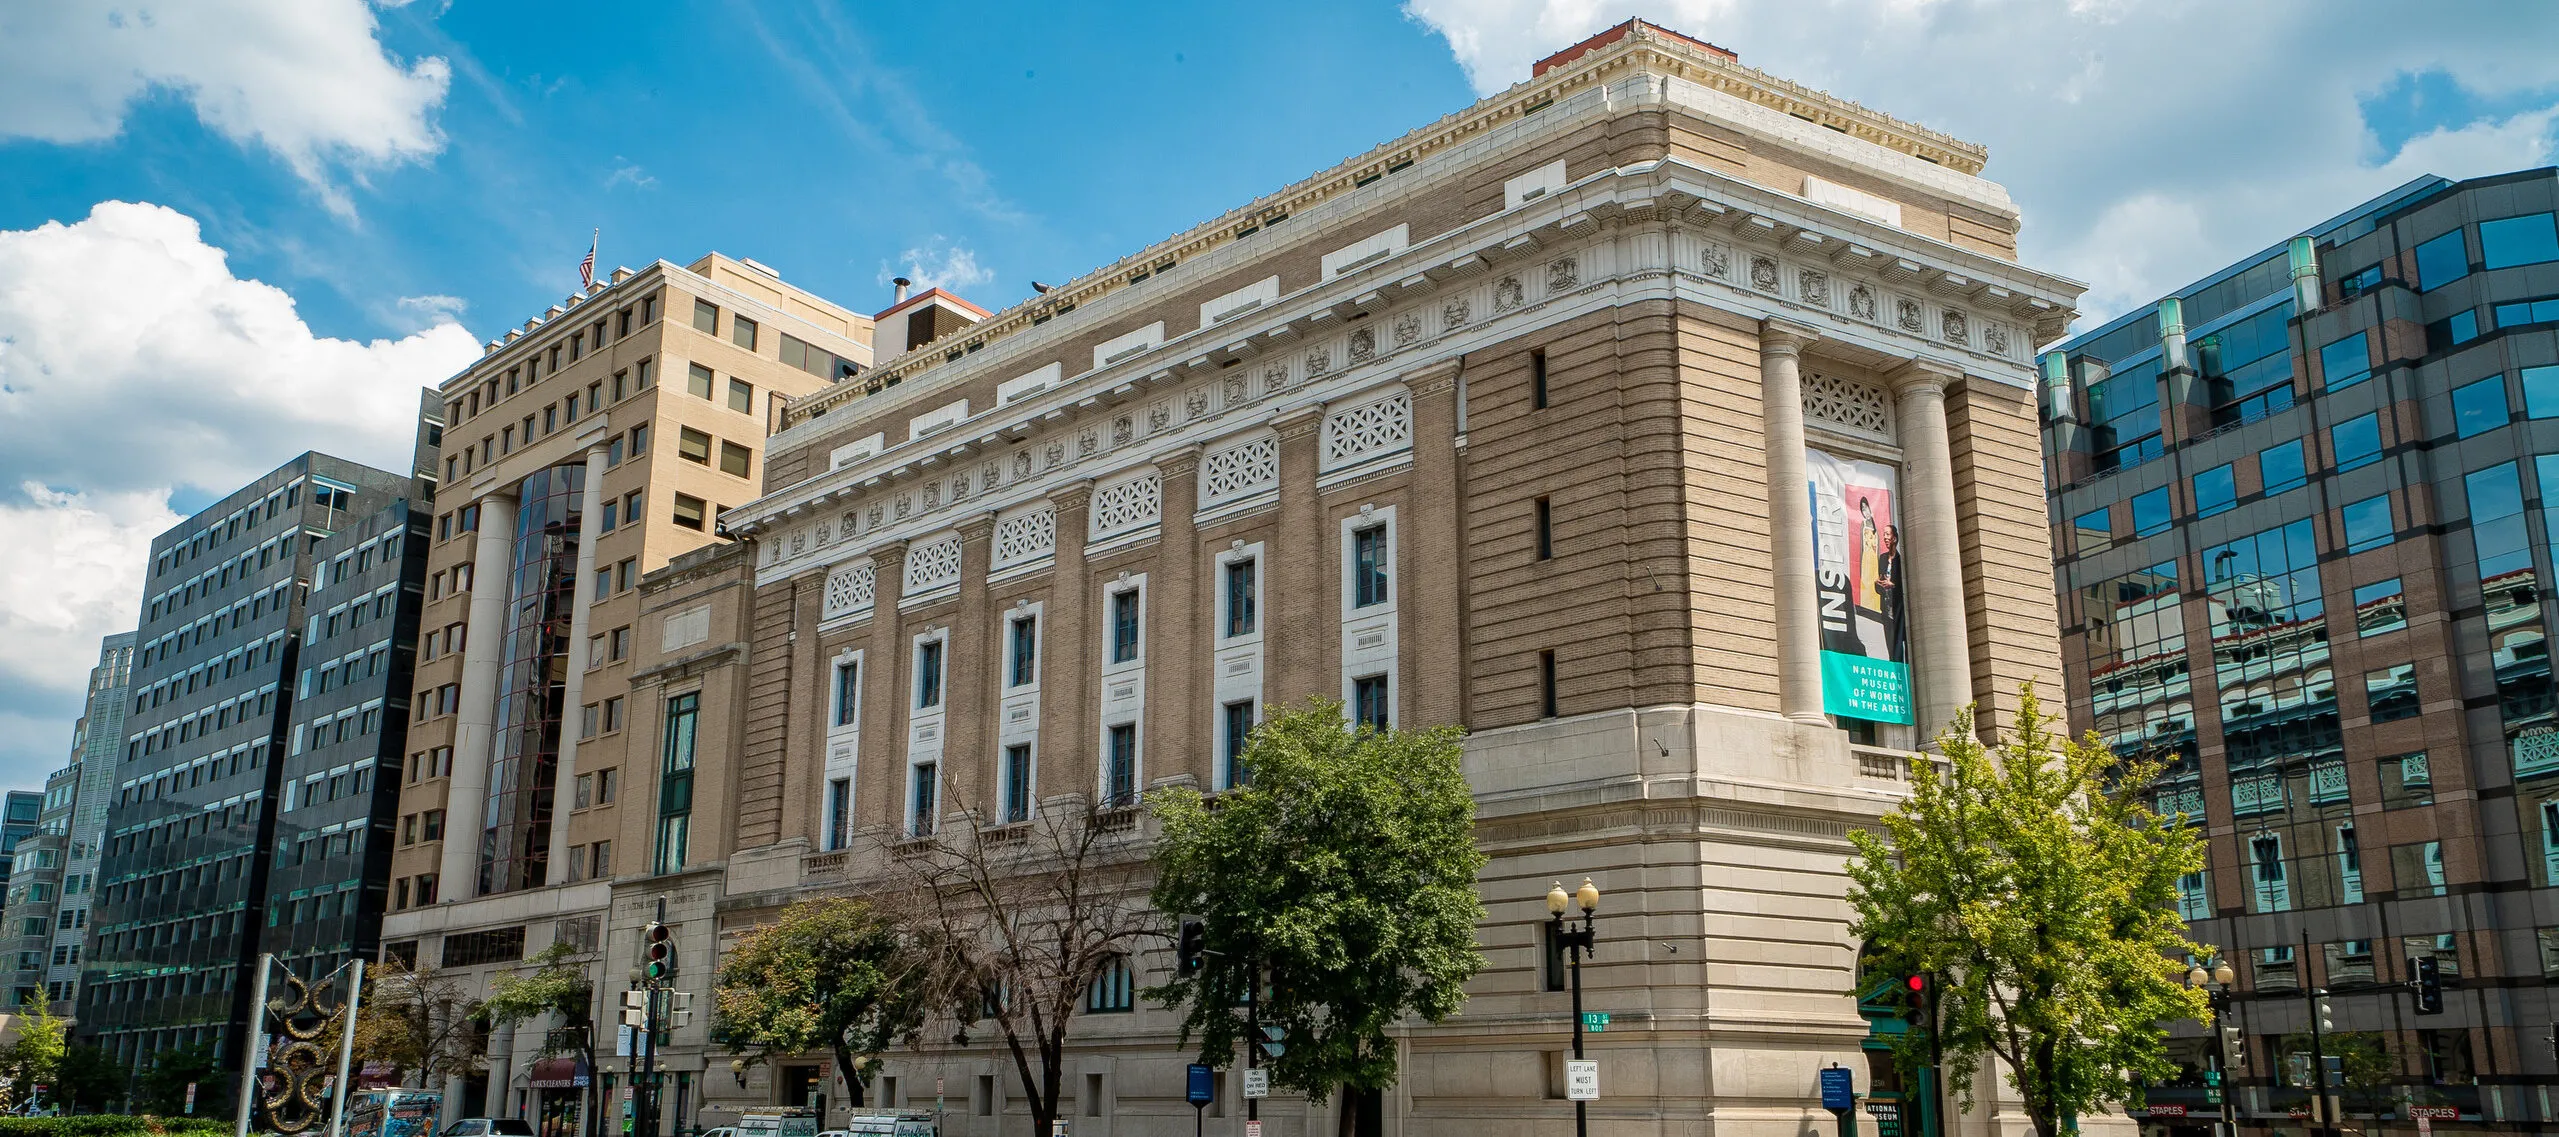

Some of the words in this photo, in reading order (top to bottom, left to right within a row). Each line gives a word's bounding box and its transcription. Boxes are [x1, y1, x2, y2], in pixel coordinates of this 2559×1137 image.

[1852, 665, 1902, 681] NATIONAL
[1861, 677, 1903, 692] MUSEUM
[1853, 688, 1866, 698] OF
[1869, 690, 1905, 703] WOMEN
[1848, 698, 1858, 708] IN
[1860, 700, 1878, 711] THE
[1881, 703, 1906, 714] ARTS
[1588, 1014, 1598, 1024] 13
[1575, 1076, 1591, 1084] MUST
[2207, 1072, 2215, 1080] 13
[546, 1079, 571, 1088] CLEANERS
[2150, 1106, 2184, 1115] STAPLES
[2410, 1107, 2456, 1118] STAPLES
